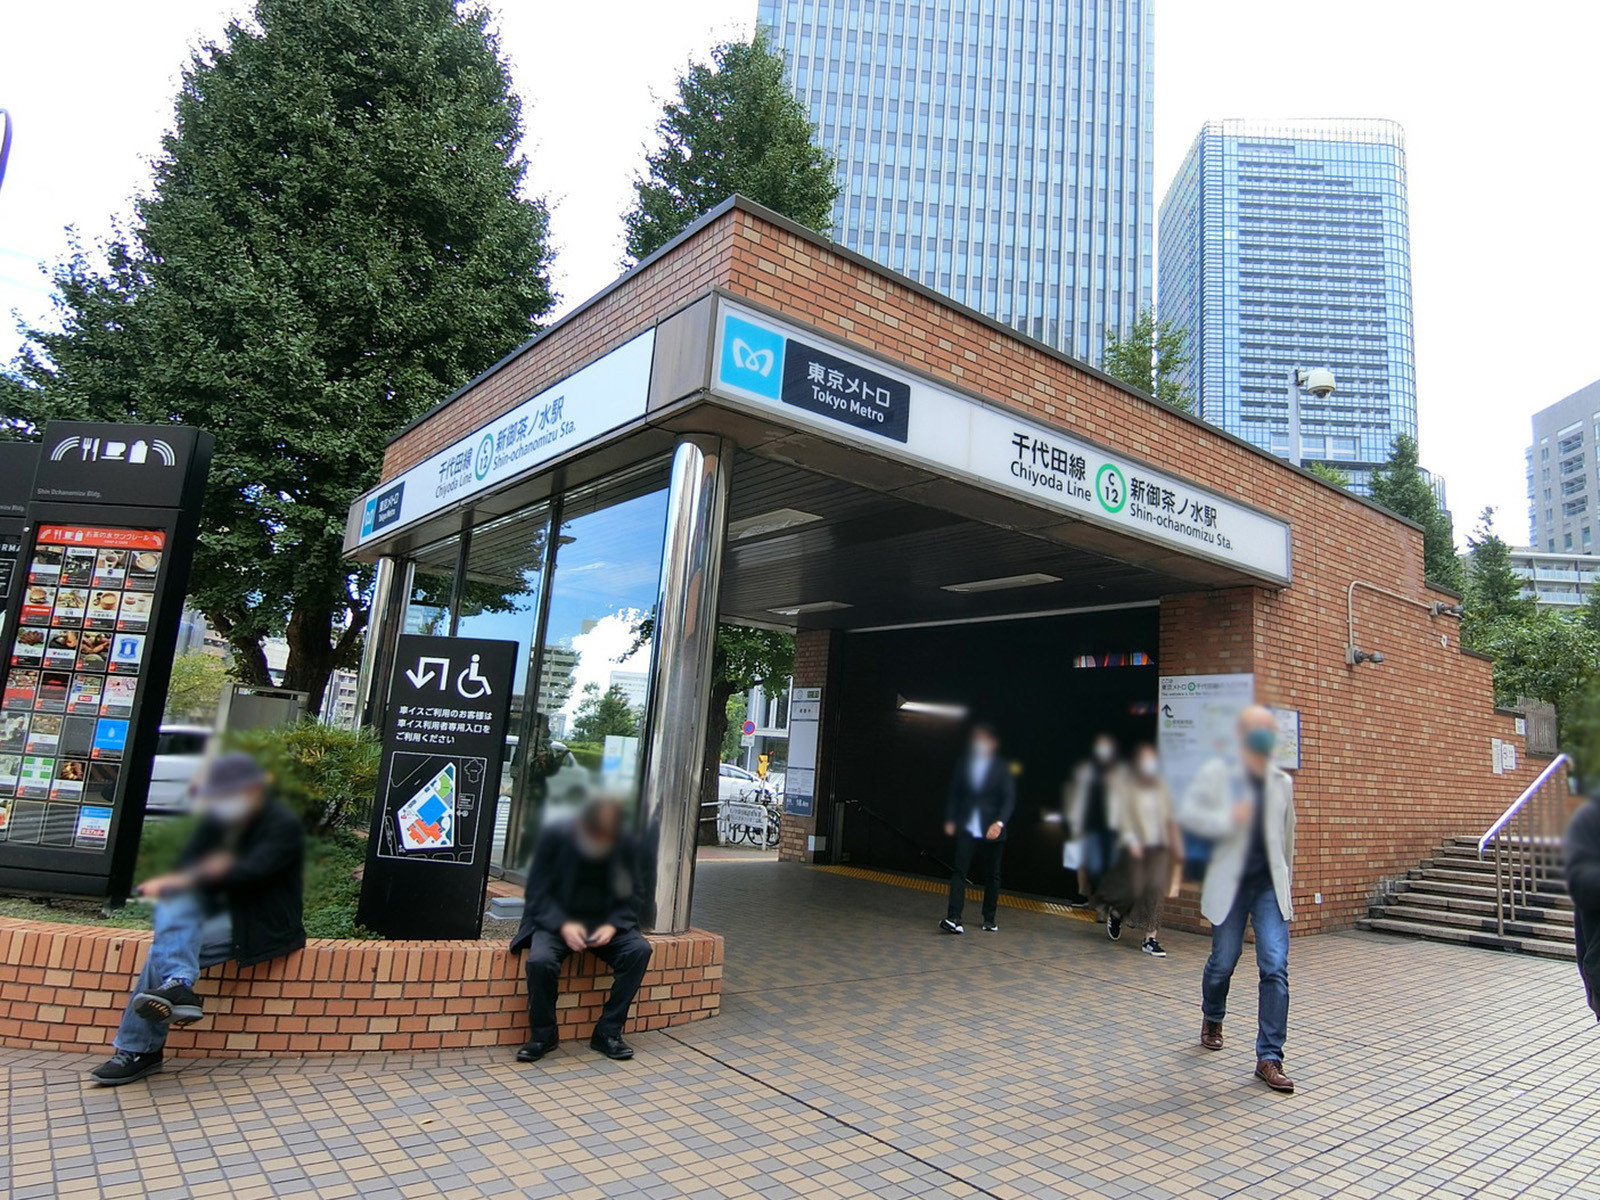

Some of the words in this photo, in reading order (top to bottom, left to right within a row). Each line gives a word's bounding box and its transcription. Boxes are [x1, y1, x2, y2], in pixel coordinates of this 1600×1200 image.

[807, 361, 890, 408] 東京メトロ
[812, 386, 847, 410] Tokyo
[850, 398, 884, 423] Metro
[495, 395, 566, 452] 新御茶ノ水駅
[438, 446, 472, 481] 千代田線
[479, 455, 489, 472] 12
[493, 431, 558, 471] Shin-ochanomizu
[560, 420, 577, 440] Sta.
[1012, 432, 1086, 481] 千代田線
[435, 478, 458, 499] Chiyoda
[459, 472, 472, 490] Line
[1011, 461, 1063, 492] Chiyoda
[1068, 478, 1092, 502] Line
[1104, 487, 1119, 504] 12
[1108, 472, 1115, 486] C
[1131, 478, 1217, 528] 新御茶ノ水駅
[1130, 504, 1214, 544] Shin-ochanomizu
[1216, 533, 1234, 550] Sta.
[397, 719, 491, 734] 車イス利用者専用入口を
[400, 706, 492, 720] 車イスご利用のお客様は
[396, 732, 455, 744] ご利用ください
